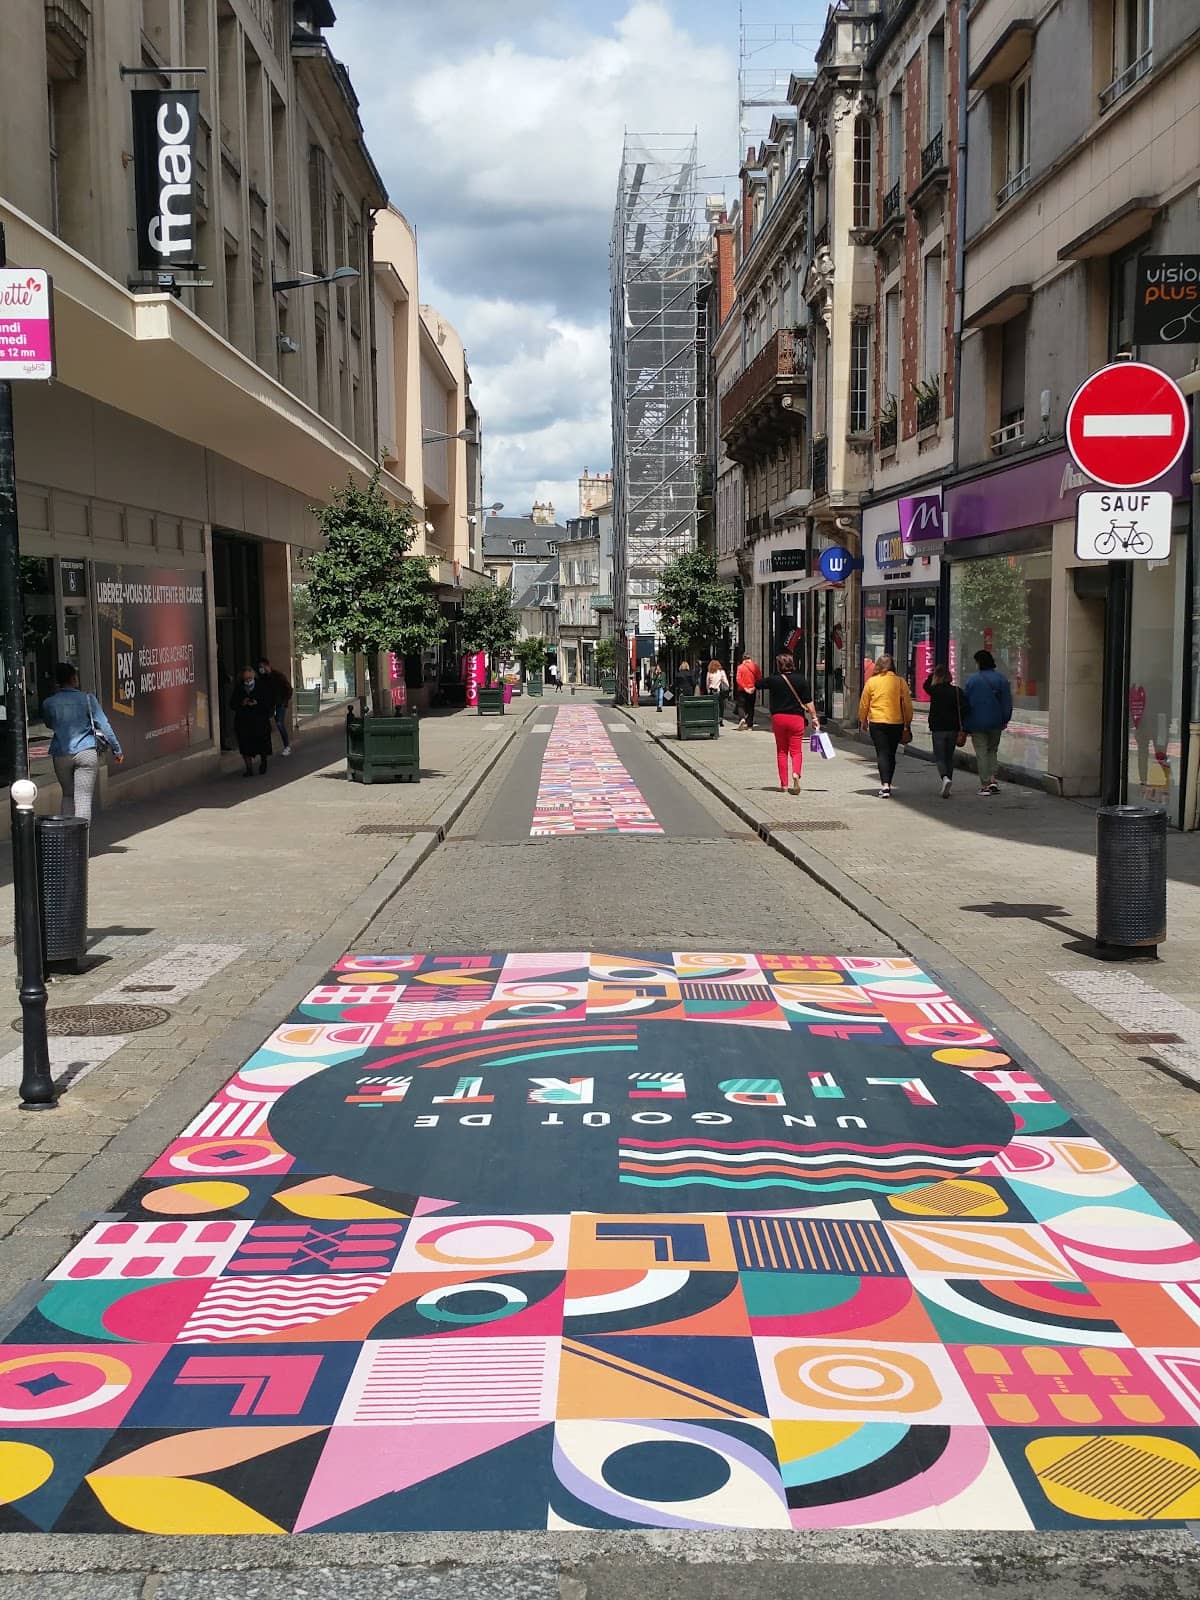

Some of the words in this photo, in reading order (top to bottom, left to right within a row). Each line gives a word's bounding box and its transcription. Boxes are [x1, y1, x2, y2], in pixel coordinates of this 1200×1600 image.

[149, 103, 192, 256] fnac
[1147, 262, 1200, 283] visio
[1145, 284, 1197, 305] plus
[8, 348, 19, 357] 12
[21, 349, 36, 357] mn
[1101, 496, 1151, 512] SAUF
[144, 584, 152, 603] DE
[117, 652, 134, 680] PAY
[125, 680, 135, 699] GO
[140, 671, 156, 693] AVEC
[413, 1113, 493, 1128] DE
[783, 1114, 868, 1129] UN
